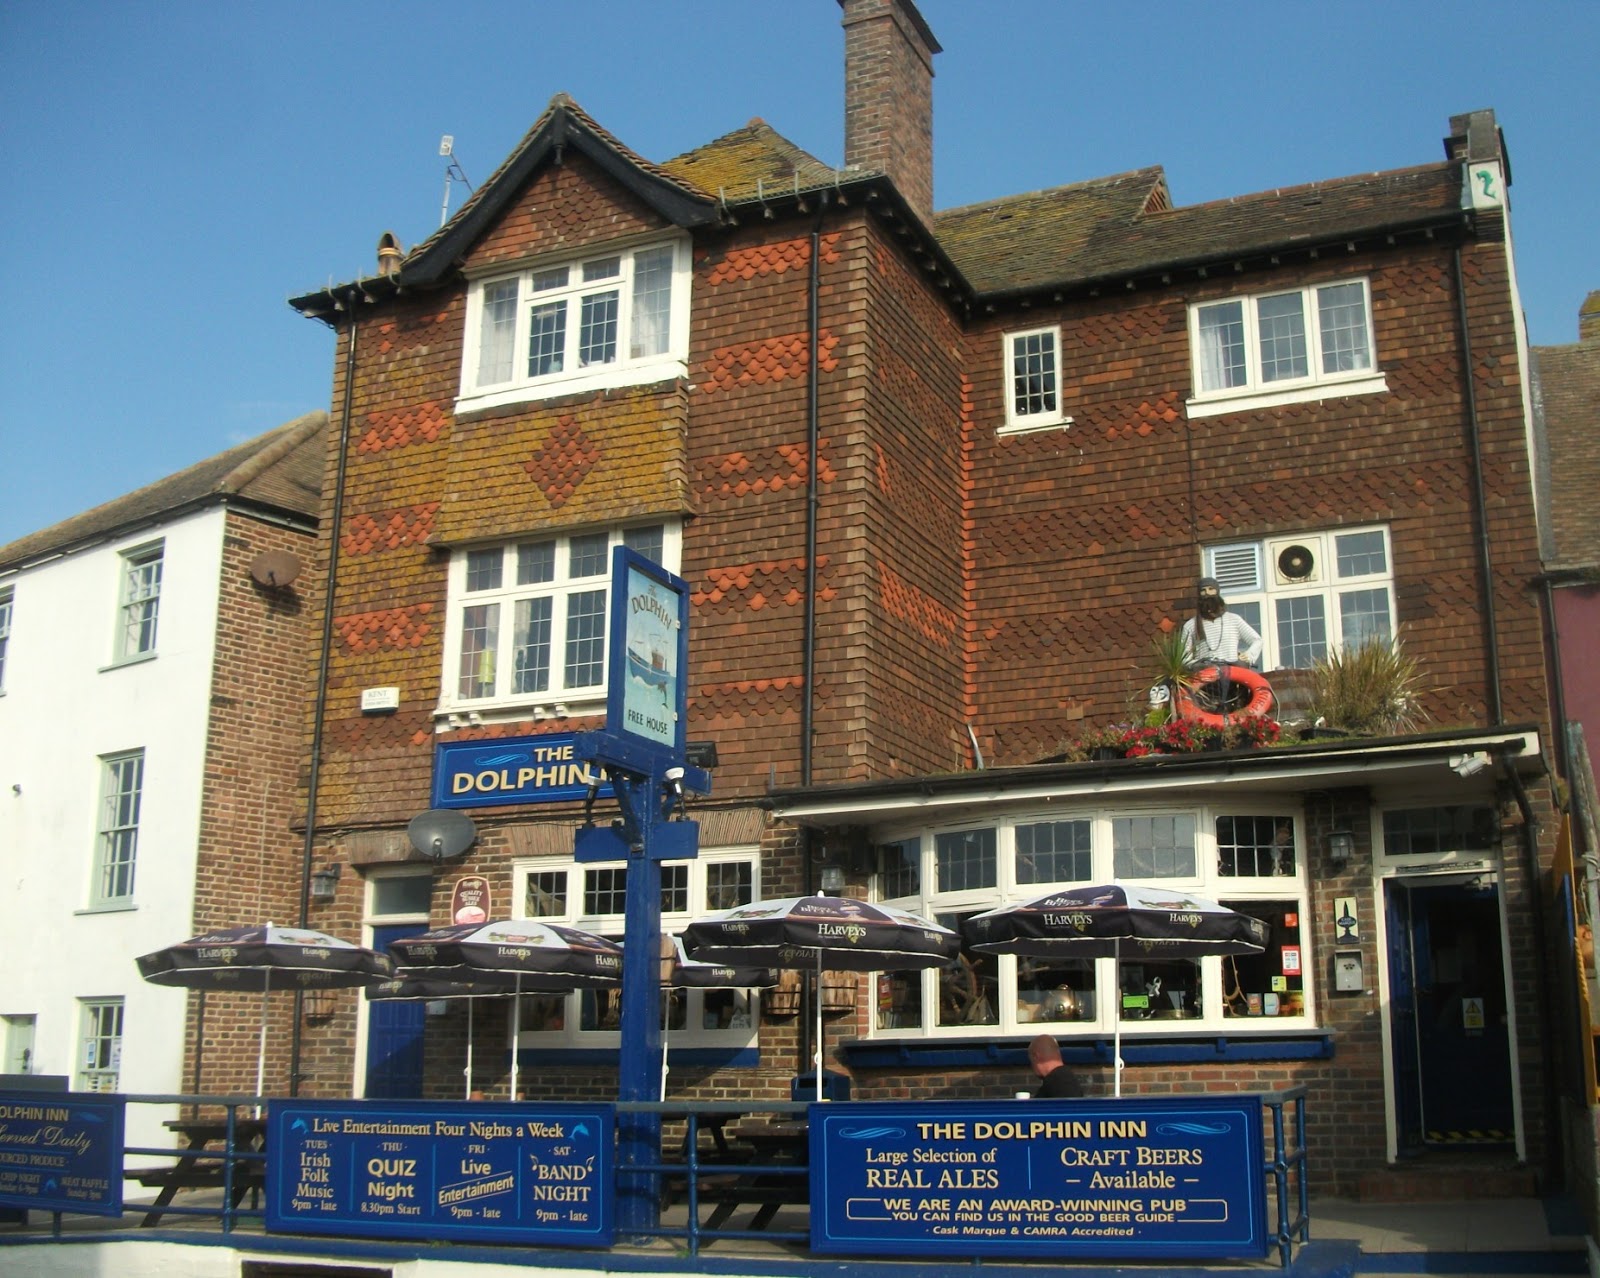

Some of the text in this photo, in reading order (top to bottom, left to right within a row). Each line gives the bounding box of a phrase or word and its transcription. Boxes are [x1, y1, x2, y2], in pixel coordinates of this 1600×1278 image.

[631, 594, 672, 631] DOLPHIN
[628, 709, 668, 735] FREE HOUSE
[534, 745, 574, 762] THE
[452, 763, 591, 794] DOLPHIN
[1043, 913, 1093, 925] HARVEYS
[1170, 913, 1203, 922] HARVEYS
[818, 923, 867, 936] HARVEYS
[197, 948, 238, 958] HARVEYS
[498, 946, 531, 956] HARVEYS
[46, 1107, 69, 1121] INN
[313, 1118, 564, 1139] Live Entertainment Four Nights a Week
[916, 1120, 1147, 1140] THE DOLPHIN INN
[43, 1125, 91, 1155] Daily
[305, 1140, 328, 1149] TUES
[381, 1142, 403, 1151] THU
[468, 1145, 485, 1154] FRI
[553, 1147, 571, 1156] SAT
[866, 1147, 998, 1165] Large Selection of
[1060, 1146, 1203, 1166] CRAFT BEERS
[300, 1151, 331, 1167] Irish
[301, 1167, 329, 1182] Folk
[367, 1158, 417, 1178] QUIZ
[461, 1159, 492, 1175] Live
[538, 1164, 587, 1181] BAND
[866, 1168, 1000, 1189] REAL ALES
[1089, 1170, 1176, 1189] Available
[296, 1183, 334, 1198] Music
[368, 1182, 414, 1201] Night
[438, 1175, 515, 1205] Entertainment
[533, 1185, 592, 1202] NIGHT
[291, 1199, 311, 1211] 9pm
[321, 1200, 337, 1211] late
[361, 1202, 421, 1215] 8.30pm Start
[451, 1206, 473, 1219] 9pm
[482, 1207, 501, 1218] late
[883, 1198, 1187, 1212] WE ARE AN AWARD-WINNING PUB
[536, 1209, 559, 1222] 9pm
[569, 1210, 588, 1222] late
[892, 1212, 1175, 1223] YOU CAN FIND US IN THE GOOD BEER GUIDE
[932, 1225, 1134, 1236] Cask Marque & CAMRA Accredited
